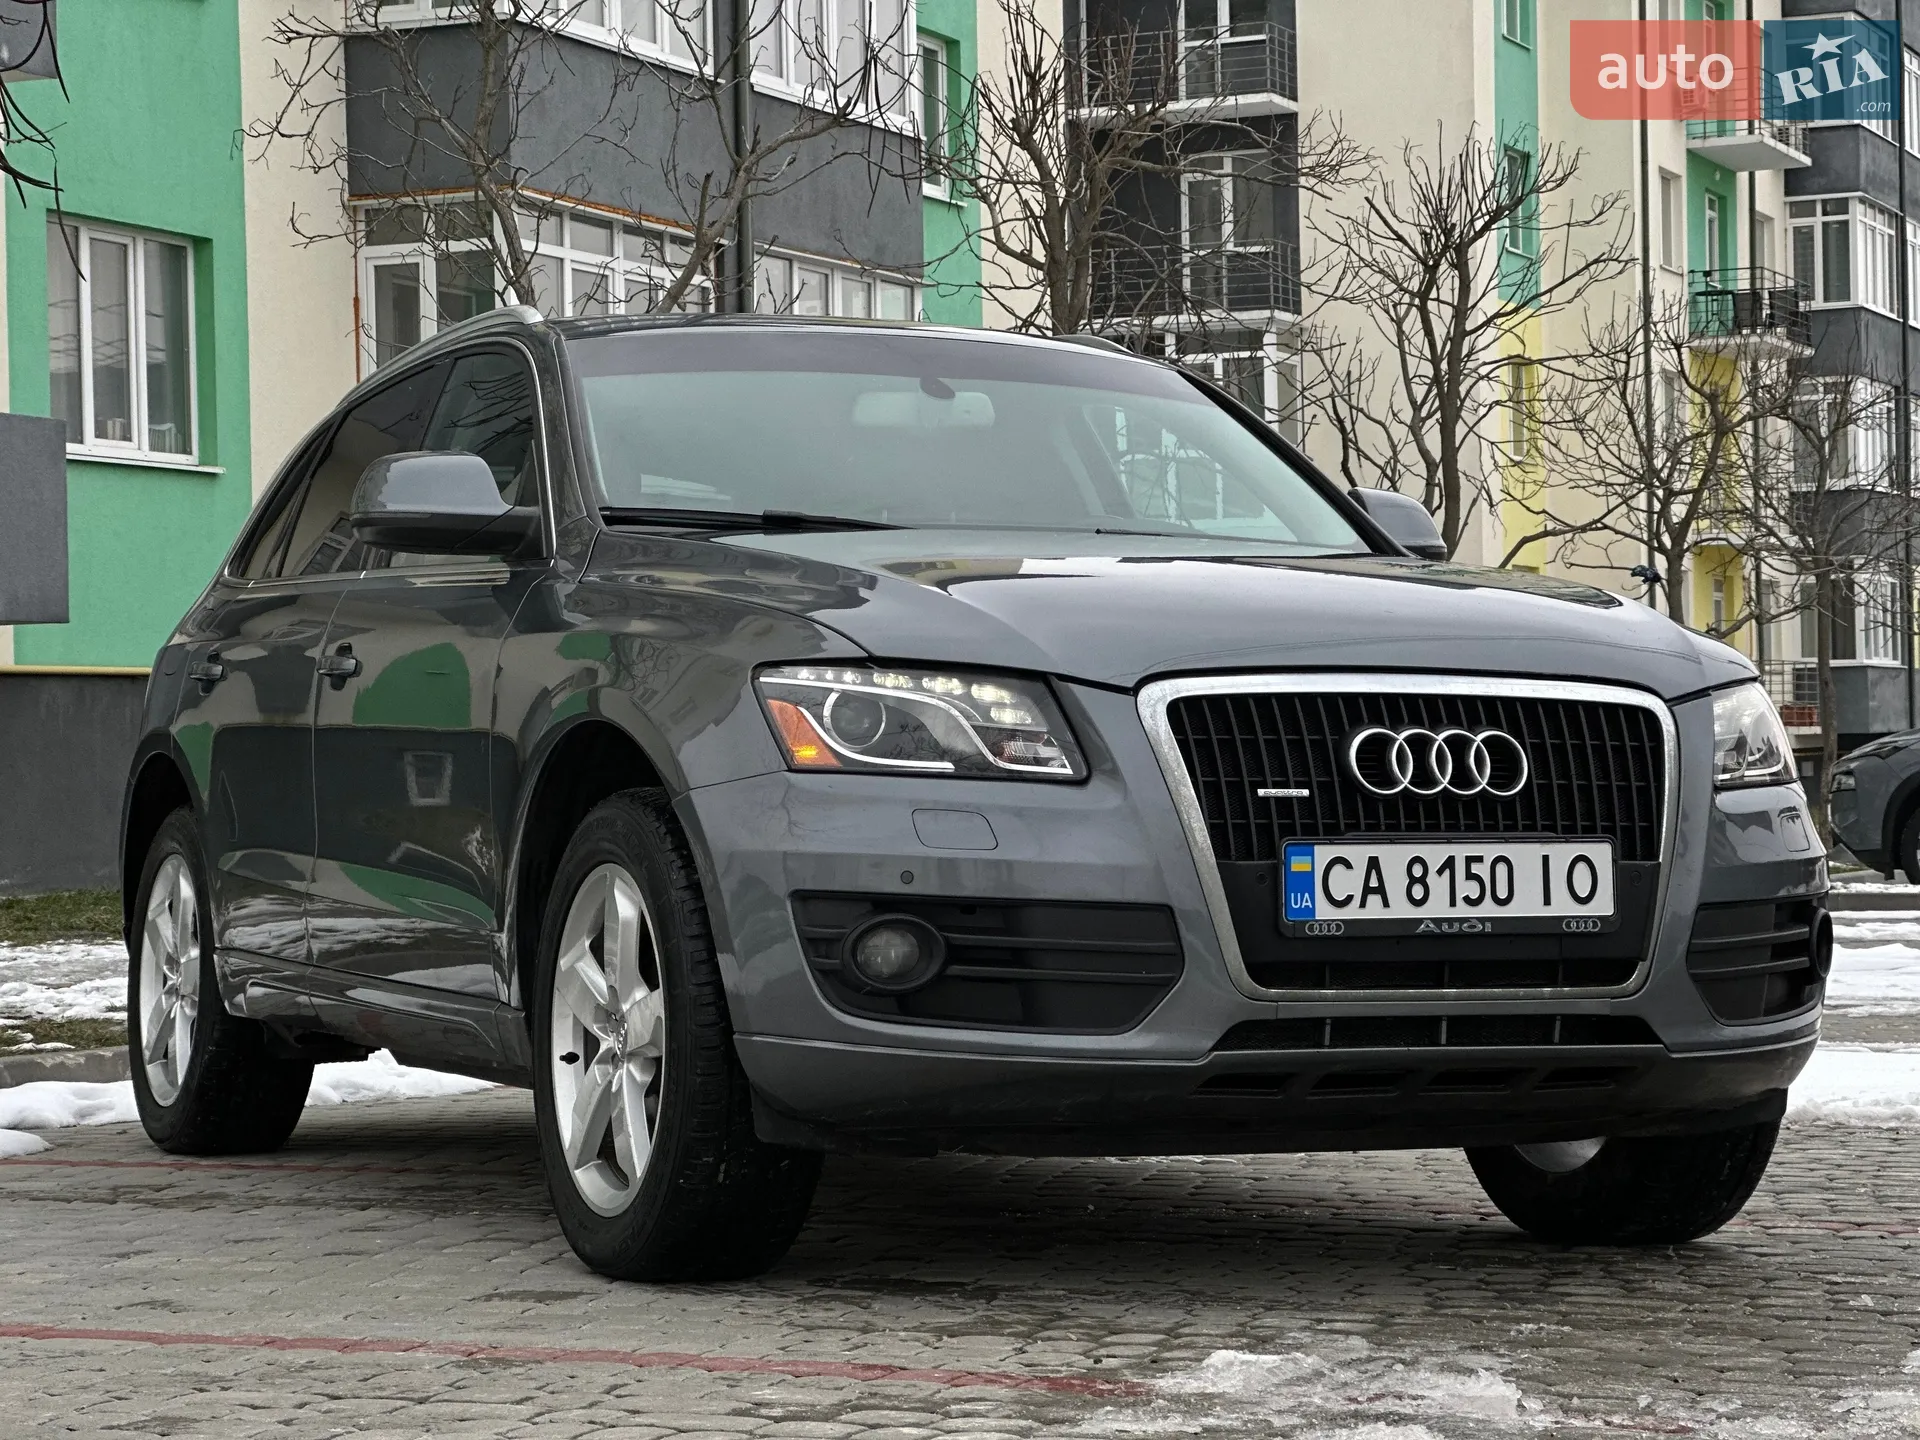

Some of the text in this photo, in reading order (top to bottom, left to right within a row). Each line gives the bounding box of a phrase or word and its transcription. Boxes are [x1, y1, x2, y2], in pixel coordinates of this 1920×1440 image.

[1321, 853, 1599, 909] CA 8150 IO
[1290, 892, 1313, 909] UA
[1415, 918, 1492, 933] Audi
